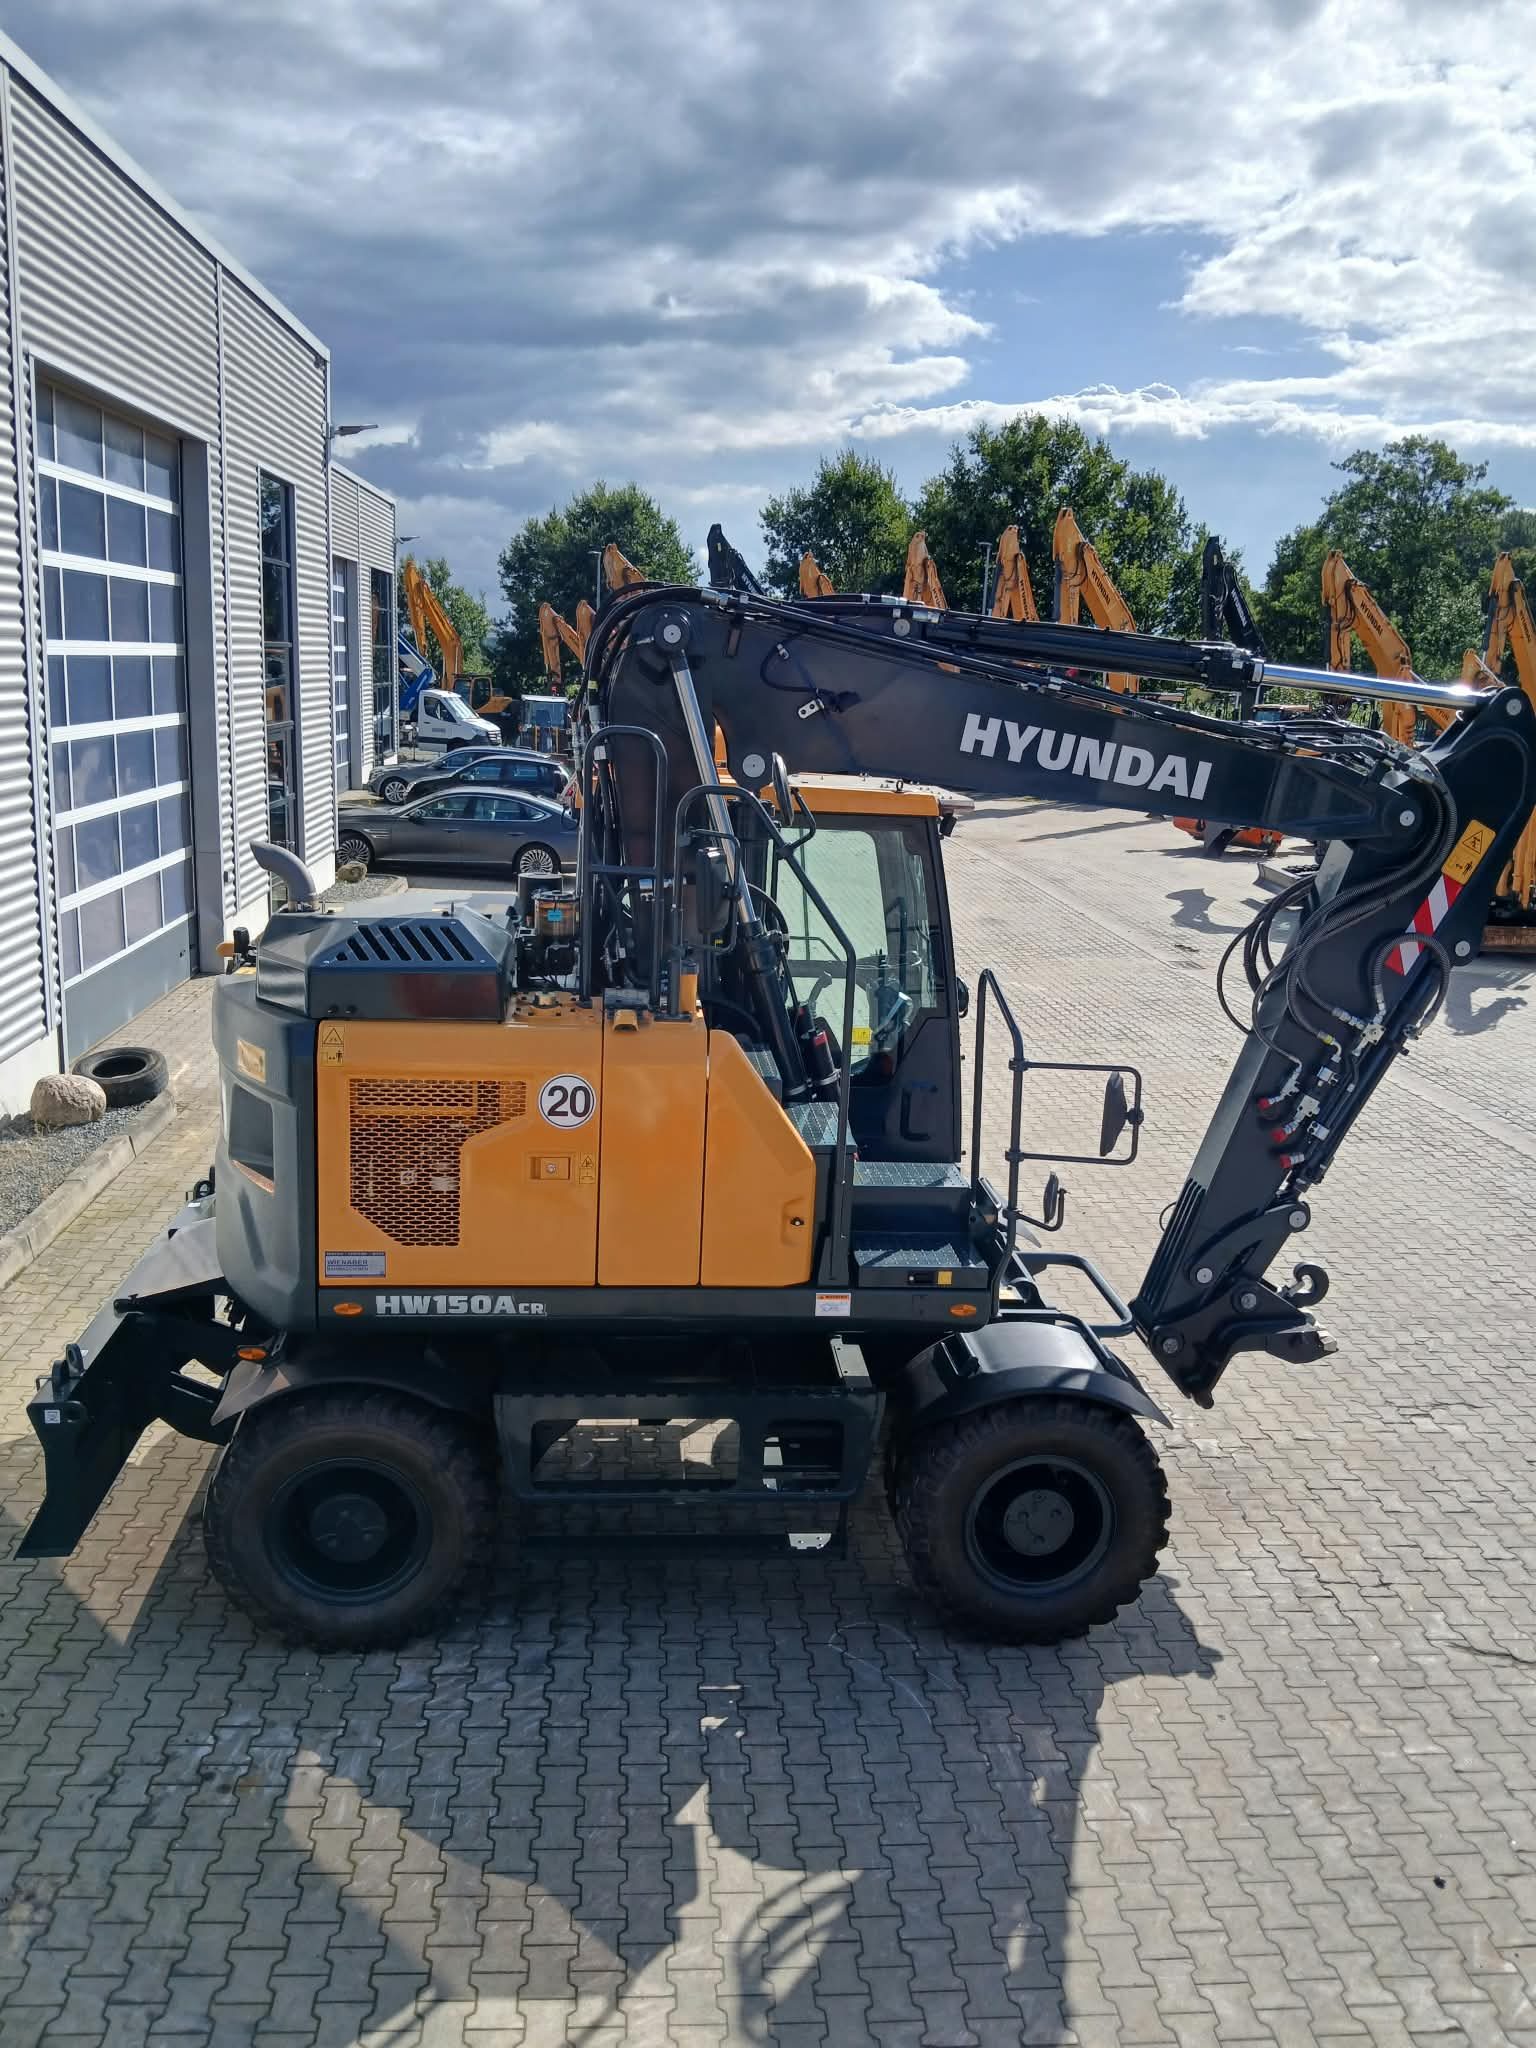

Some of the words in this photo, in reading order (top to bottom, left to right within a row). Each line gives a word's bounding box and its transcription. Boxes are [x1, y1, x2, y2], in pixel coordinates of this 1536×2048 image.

[1091, 569, 1111, 605] HYUNDAI
[1360, 600, 1384, 636] HYUNDAI
[959, 712, 1213, 801] HYUNDAI
[547, 1085, 591, 1118] 20
